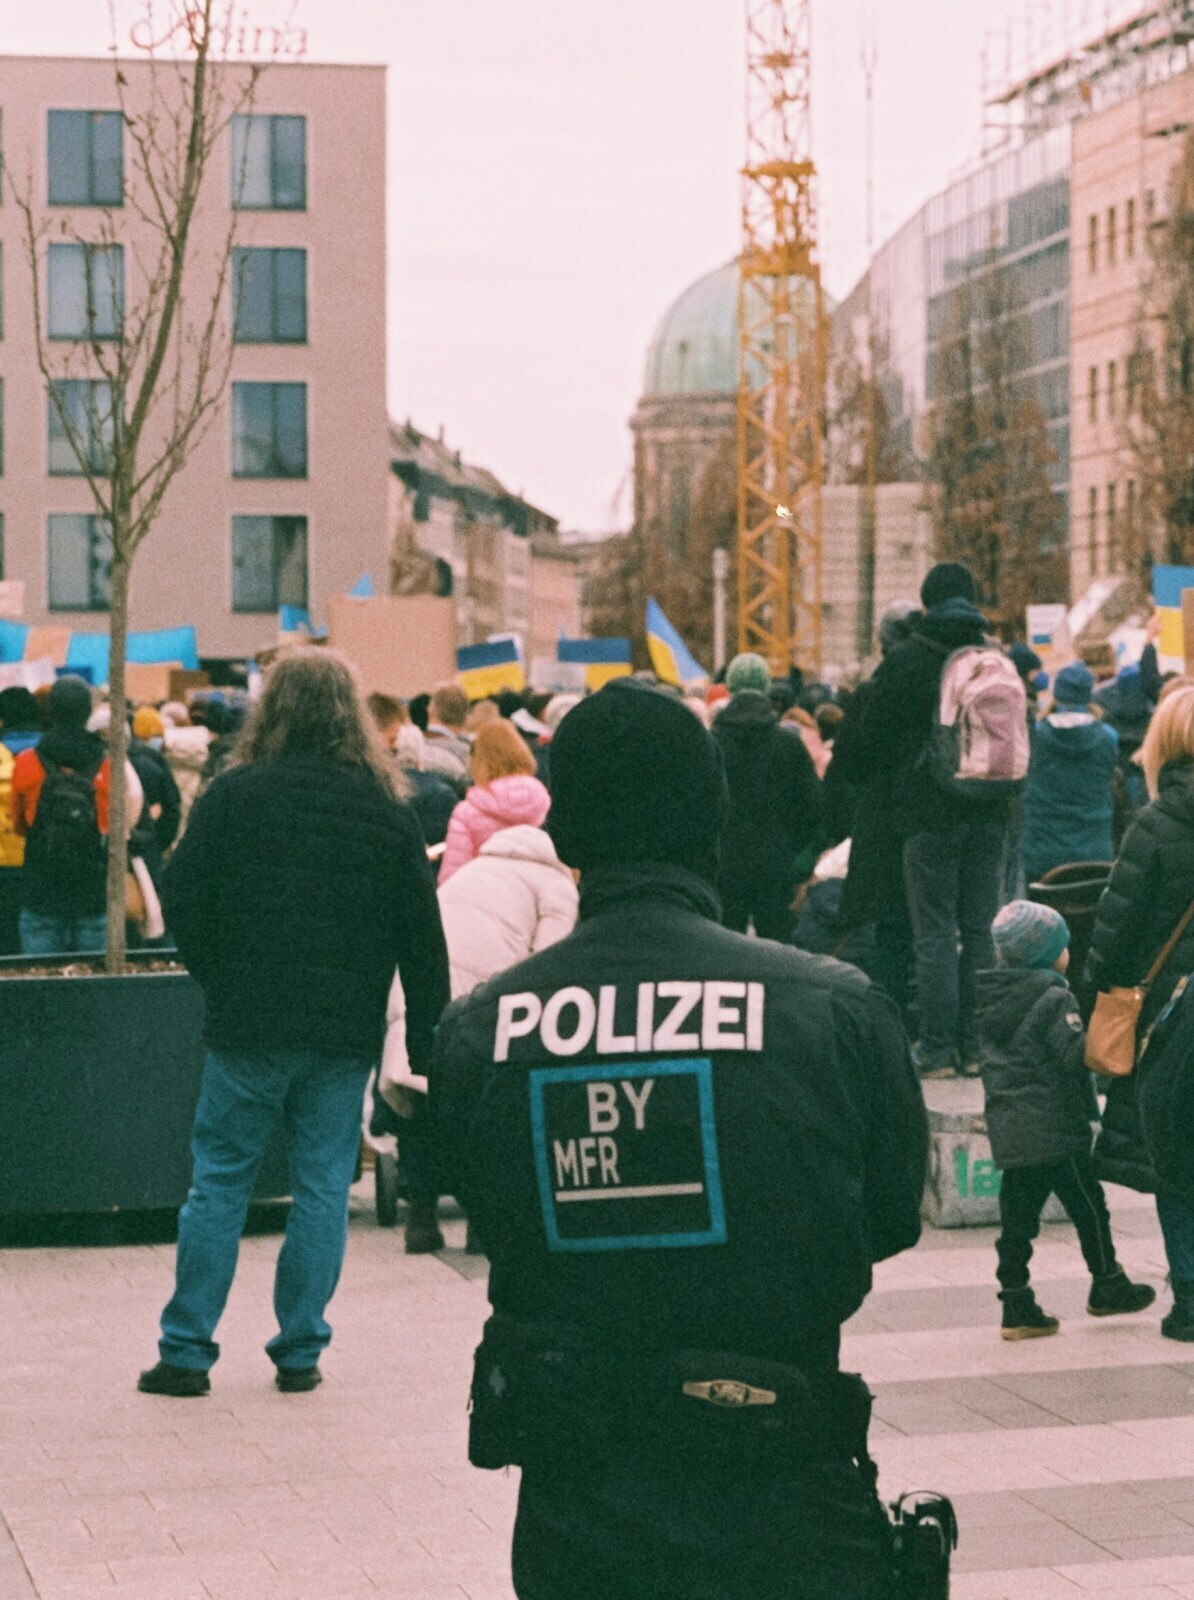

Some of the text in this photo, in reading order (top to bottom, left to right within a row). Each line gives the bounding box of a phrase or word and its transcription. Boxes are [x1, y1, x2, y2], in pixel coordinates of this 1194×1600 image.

[493, 980, 765, 1062] POLIZEI
[586, 1078, 655, 1133] BY
[552, 1135, 620, 1188] MFR
